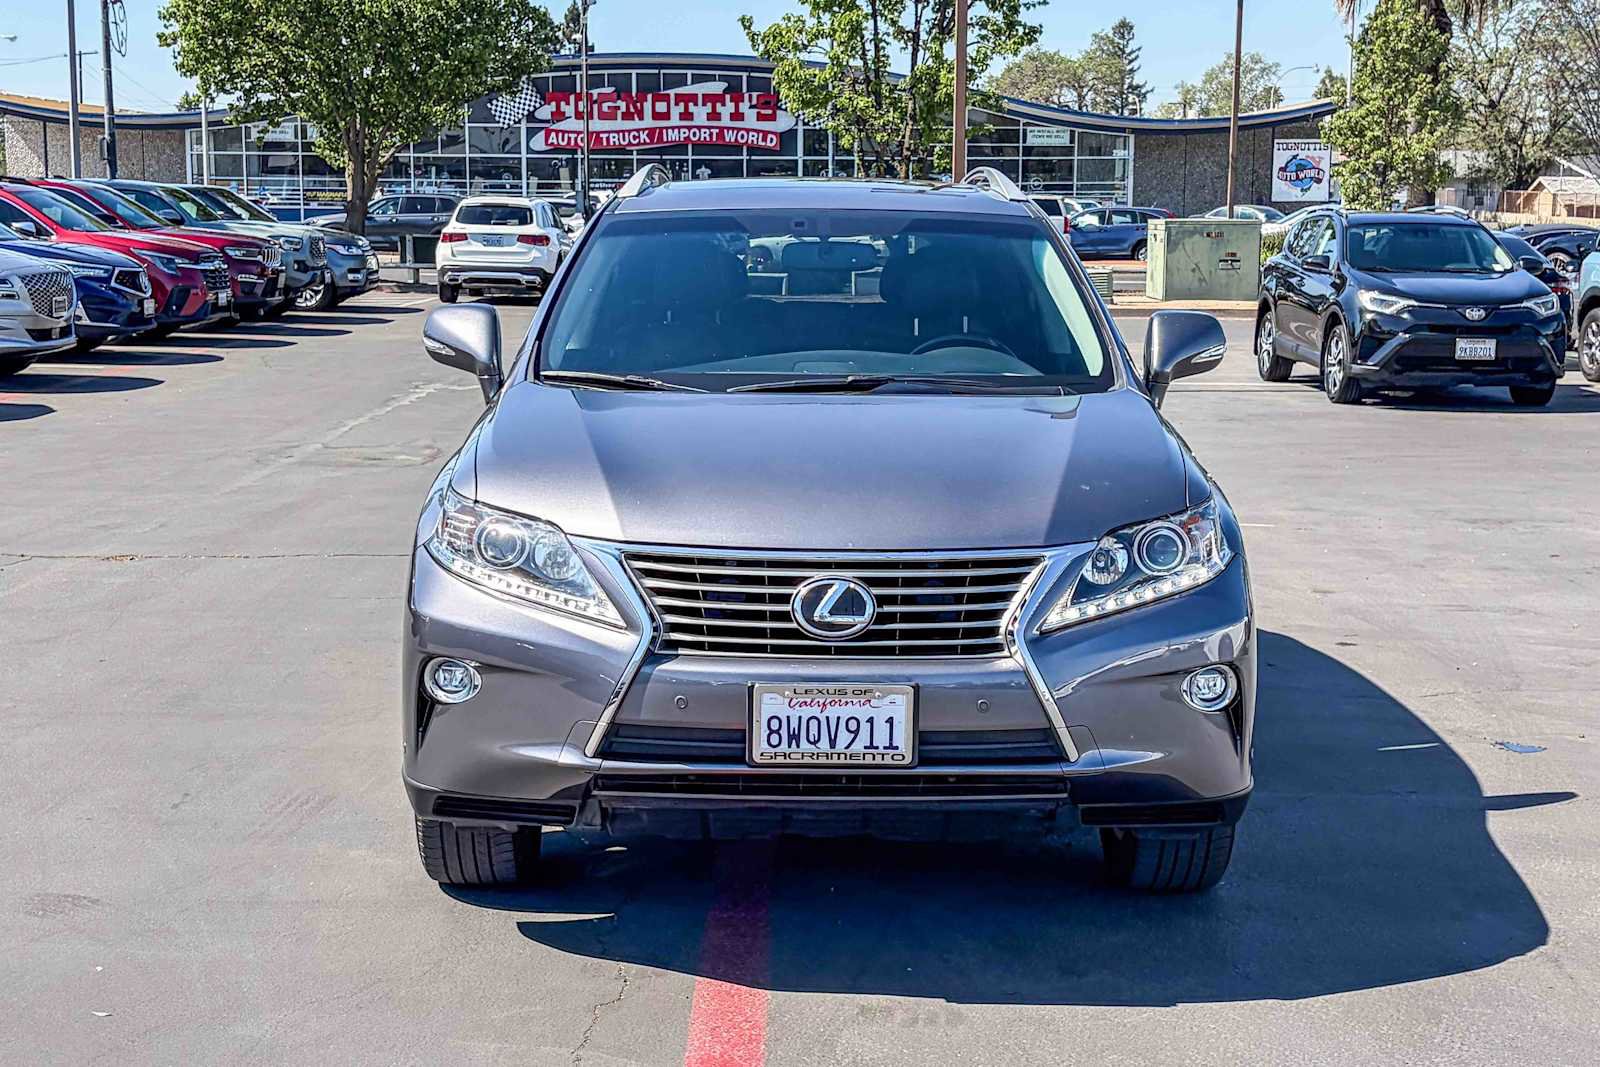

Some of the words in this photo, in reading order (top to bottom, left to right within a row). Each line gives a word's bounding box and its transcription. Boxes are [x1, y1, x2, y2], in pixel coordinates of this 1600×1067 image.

[545, 91, 778, 122] TOGNOTTI'S
[548, 131, 586, 147] AUTO
[600, 130, 651, 146] TRUCK
[663, 128, 719, 143] IMPORT
[724, 128, 778, 147] WORLD
[1297, 168, 1324, 180] WORLD
[793, 688, 849, 696] LEXUS
[852, 688, 874, 696] OF
[788, 697, 882, 713] California
[766, 715, 900, 750] 8WQV911
[759, 751, 906, 761] SACRAMENTO
